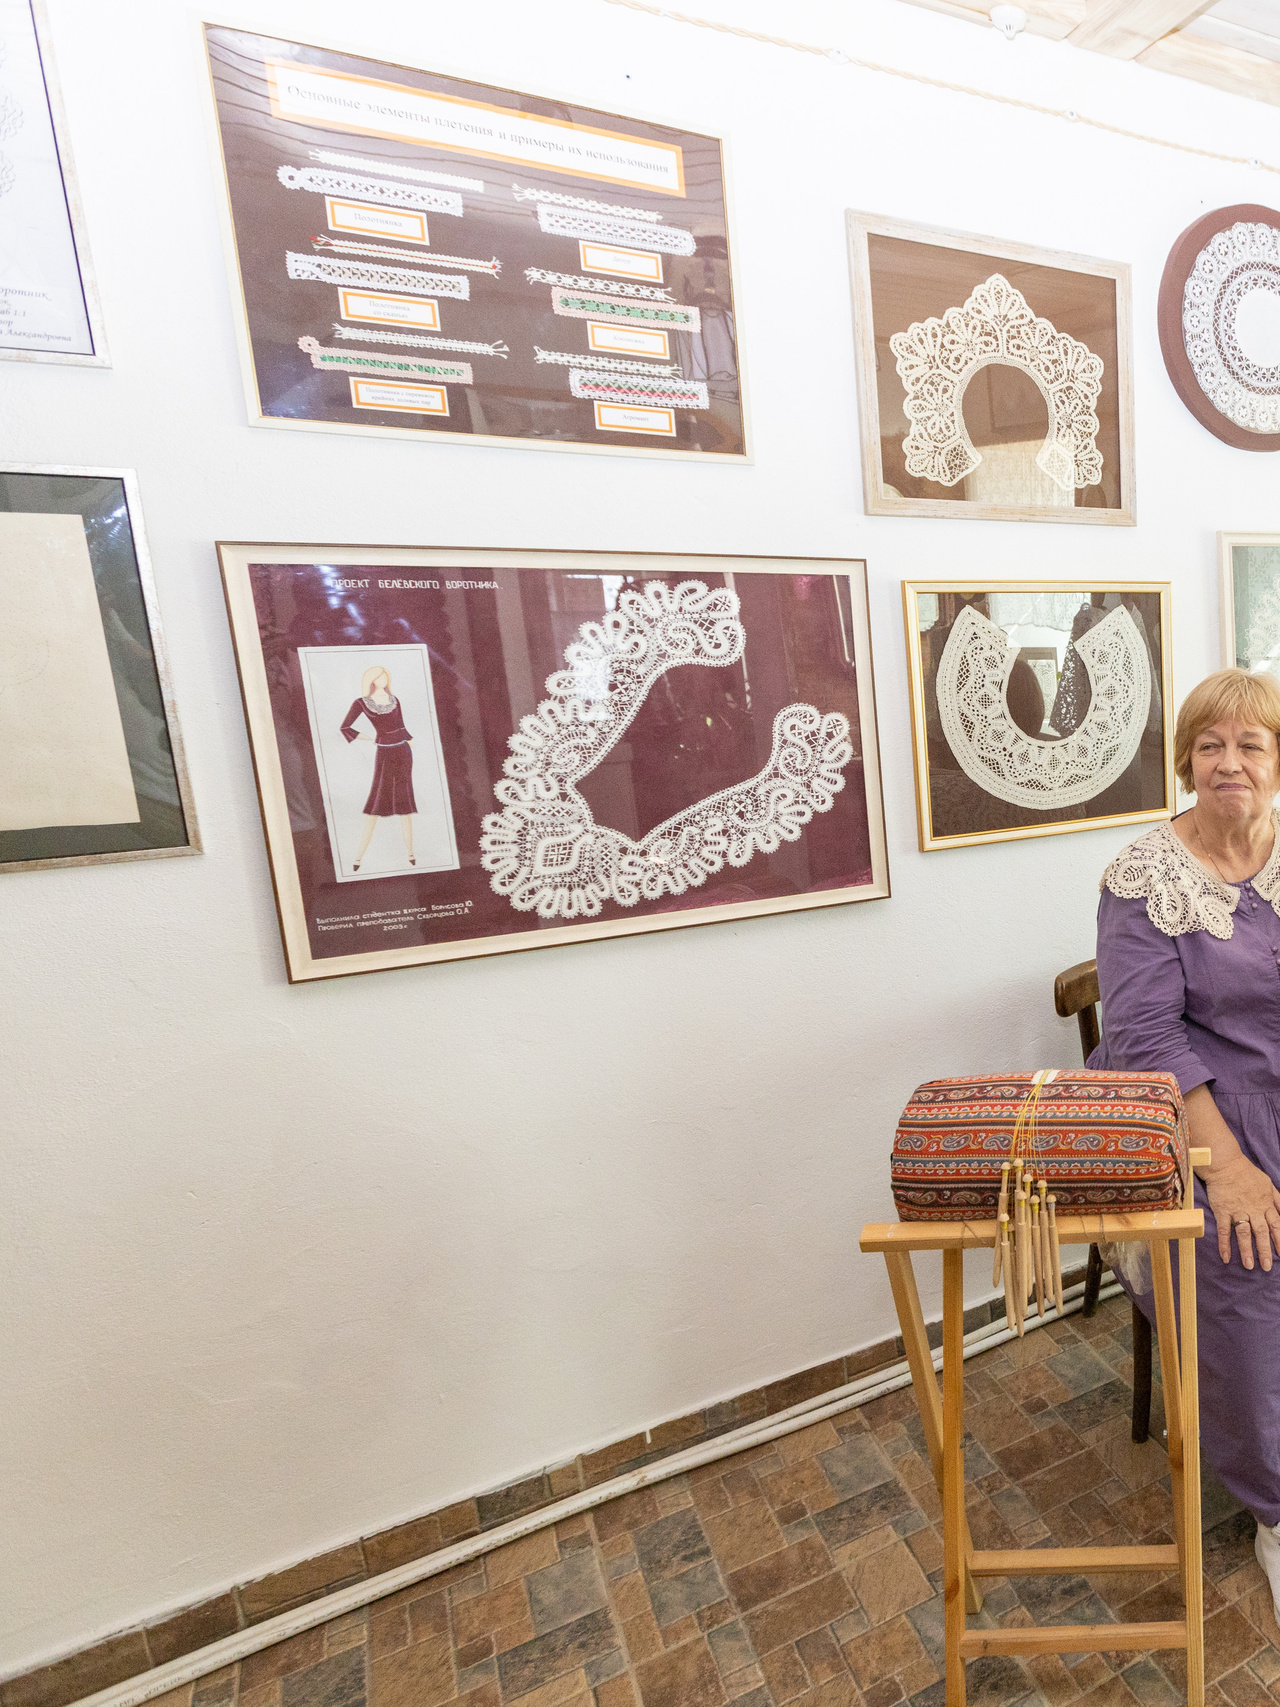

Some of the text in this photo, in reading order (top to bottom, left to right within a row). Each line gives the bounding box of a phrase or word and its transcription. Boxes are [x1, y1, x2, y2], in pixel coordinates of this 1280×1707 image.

[287, 84, 669, 174] Основные элементы плетения и примеры их использования
[354, 212, 403, 227] Полотнянка
[5, 328, 72, 342] Александровна
[331, 579, 370, 589] ПРОЕКТ
[378, 578, 440, 589] БЕЛЁВСКОГО
